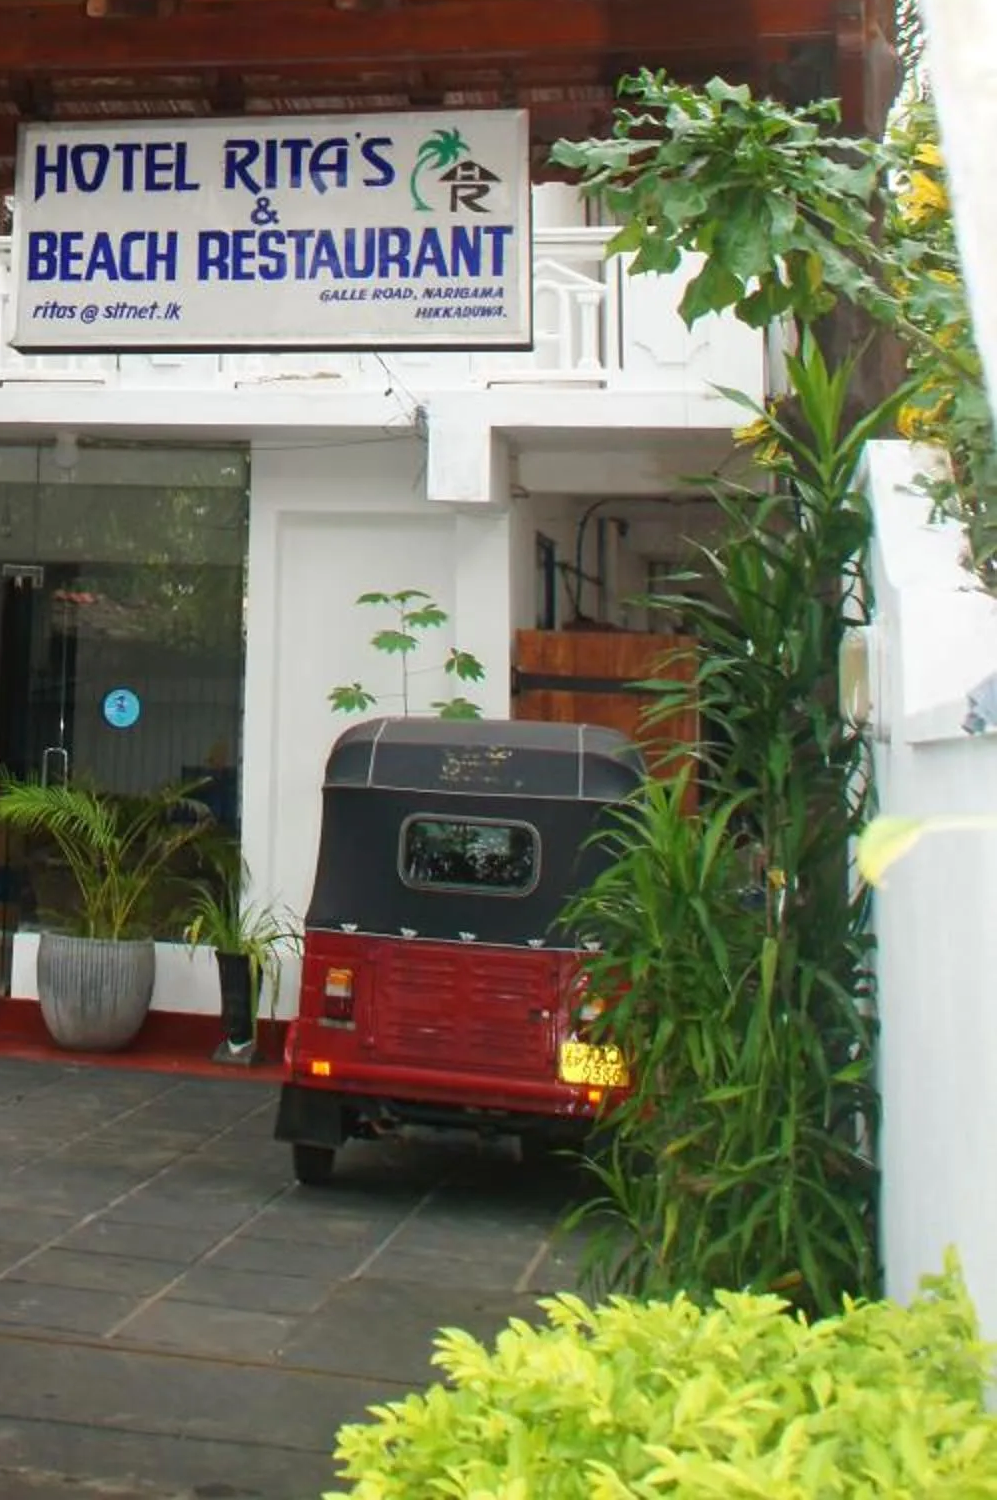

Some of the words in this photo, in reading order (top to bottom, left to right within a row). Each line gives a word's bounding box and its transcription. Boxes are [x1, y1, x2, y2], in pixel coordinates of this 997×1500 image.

[34, 141, 201, 202] HOTEL
[223, 132, 396, 195] RITA'S
[250, 196, 280, 225] &
[27, 230, 179, 282] BEACH
[197, 225, 514, 281] RESTAURANT
[319, 288, 367, 301] GALLE
[371, 286, 418, 301] ROAD,
[422, 286, 505, 300] NARIGAMA
[32, 301, 77, 320] ritas
[80, 304, 100, 324] @
[414, 305, 508, 320] HIKKADUWA.
